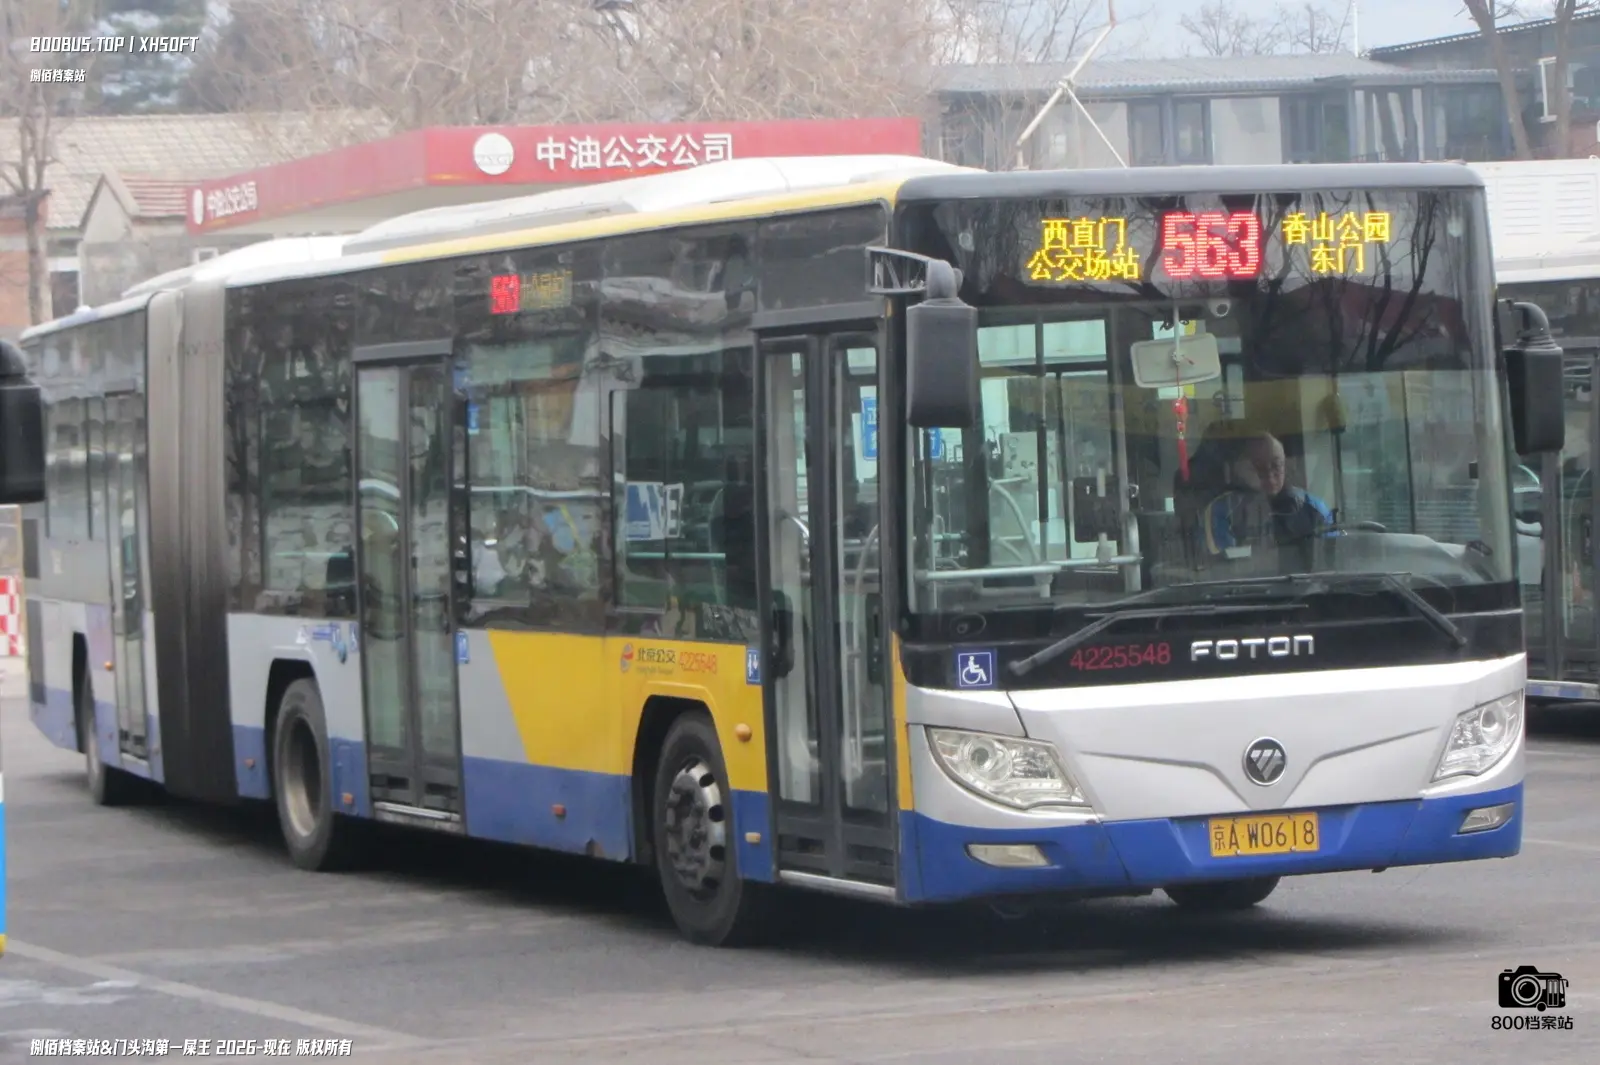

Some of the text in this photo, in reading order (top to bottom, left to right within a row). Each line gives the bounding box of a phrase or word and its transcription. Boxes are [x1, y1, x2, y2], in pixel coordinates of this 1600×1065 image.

[536, 133, 733, 170] 中油公交公司
[1041, 217, 1126, 250] 西直门
[1281, 211, 1391, 244] 香山公园
[1163, 212, 1261, 277] 563
[1311, 243, 1365, 274] 东门
[1027, 248, 1140, 281] 公交场站
[637, 647, 676, 664] 北京公交
[1070, 635, 1315, 671] 4225548 FOTON
